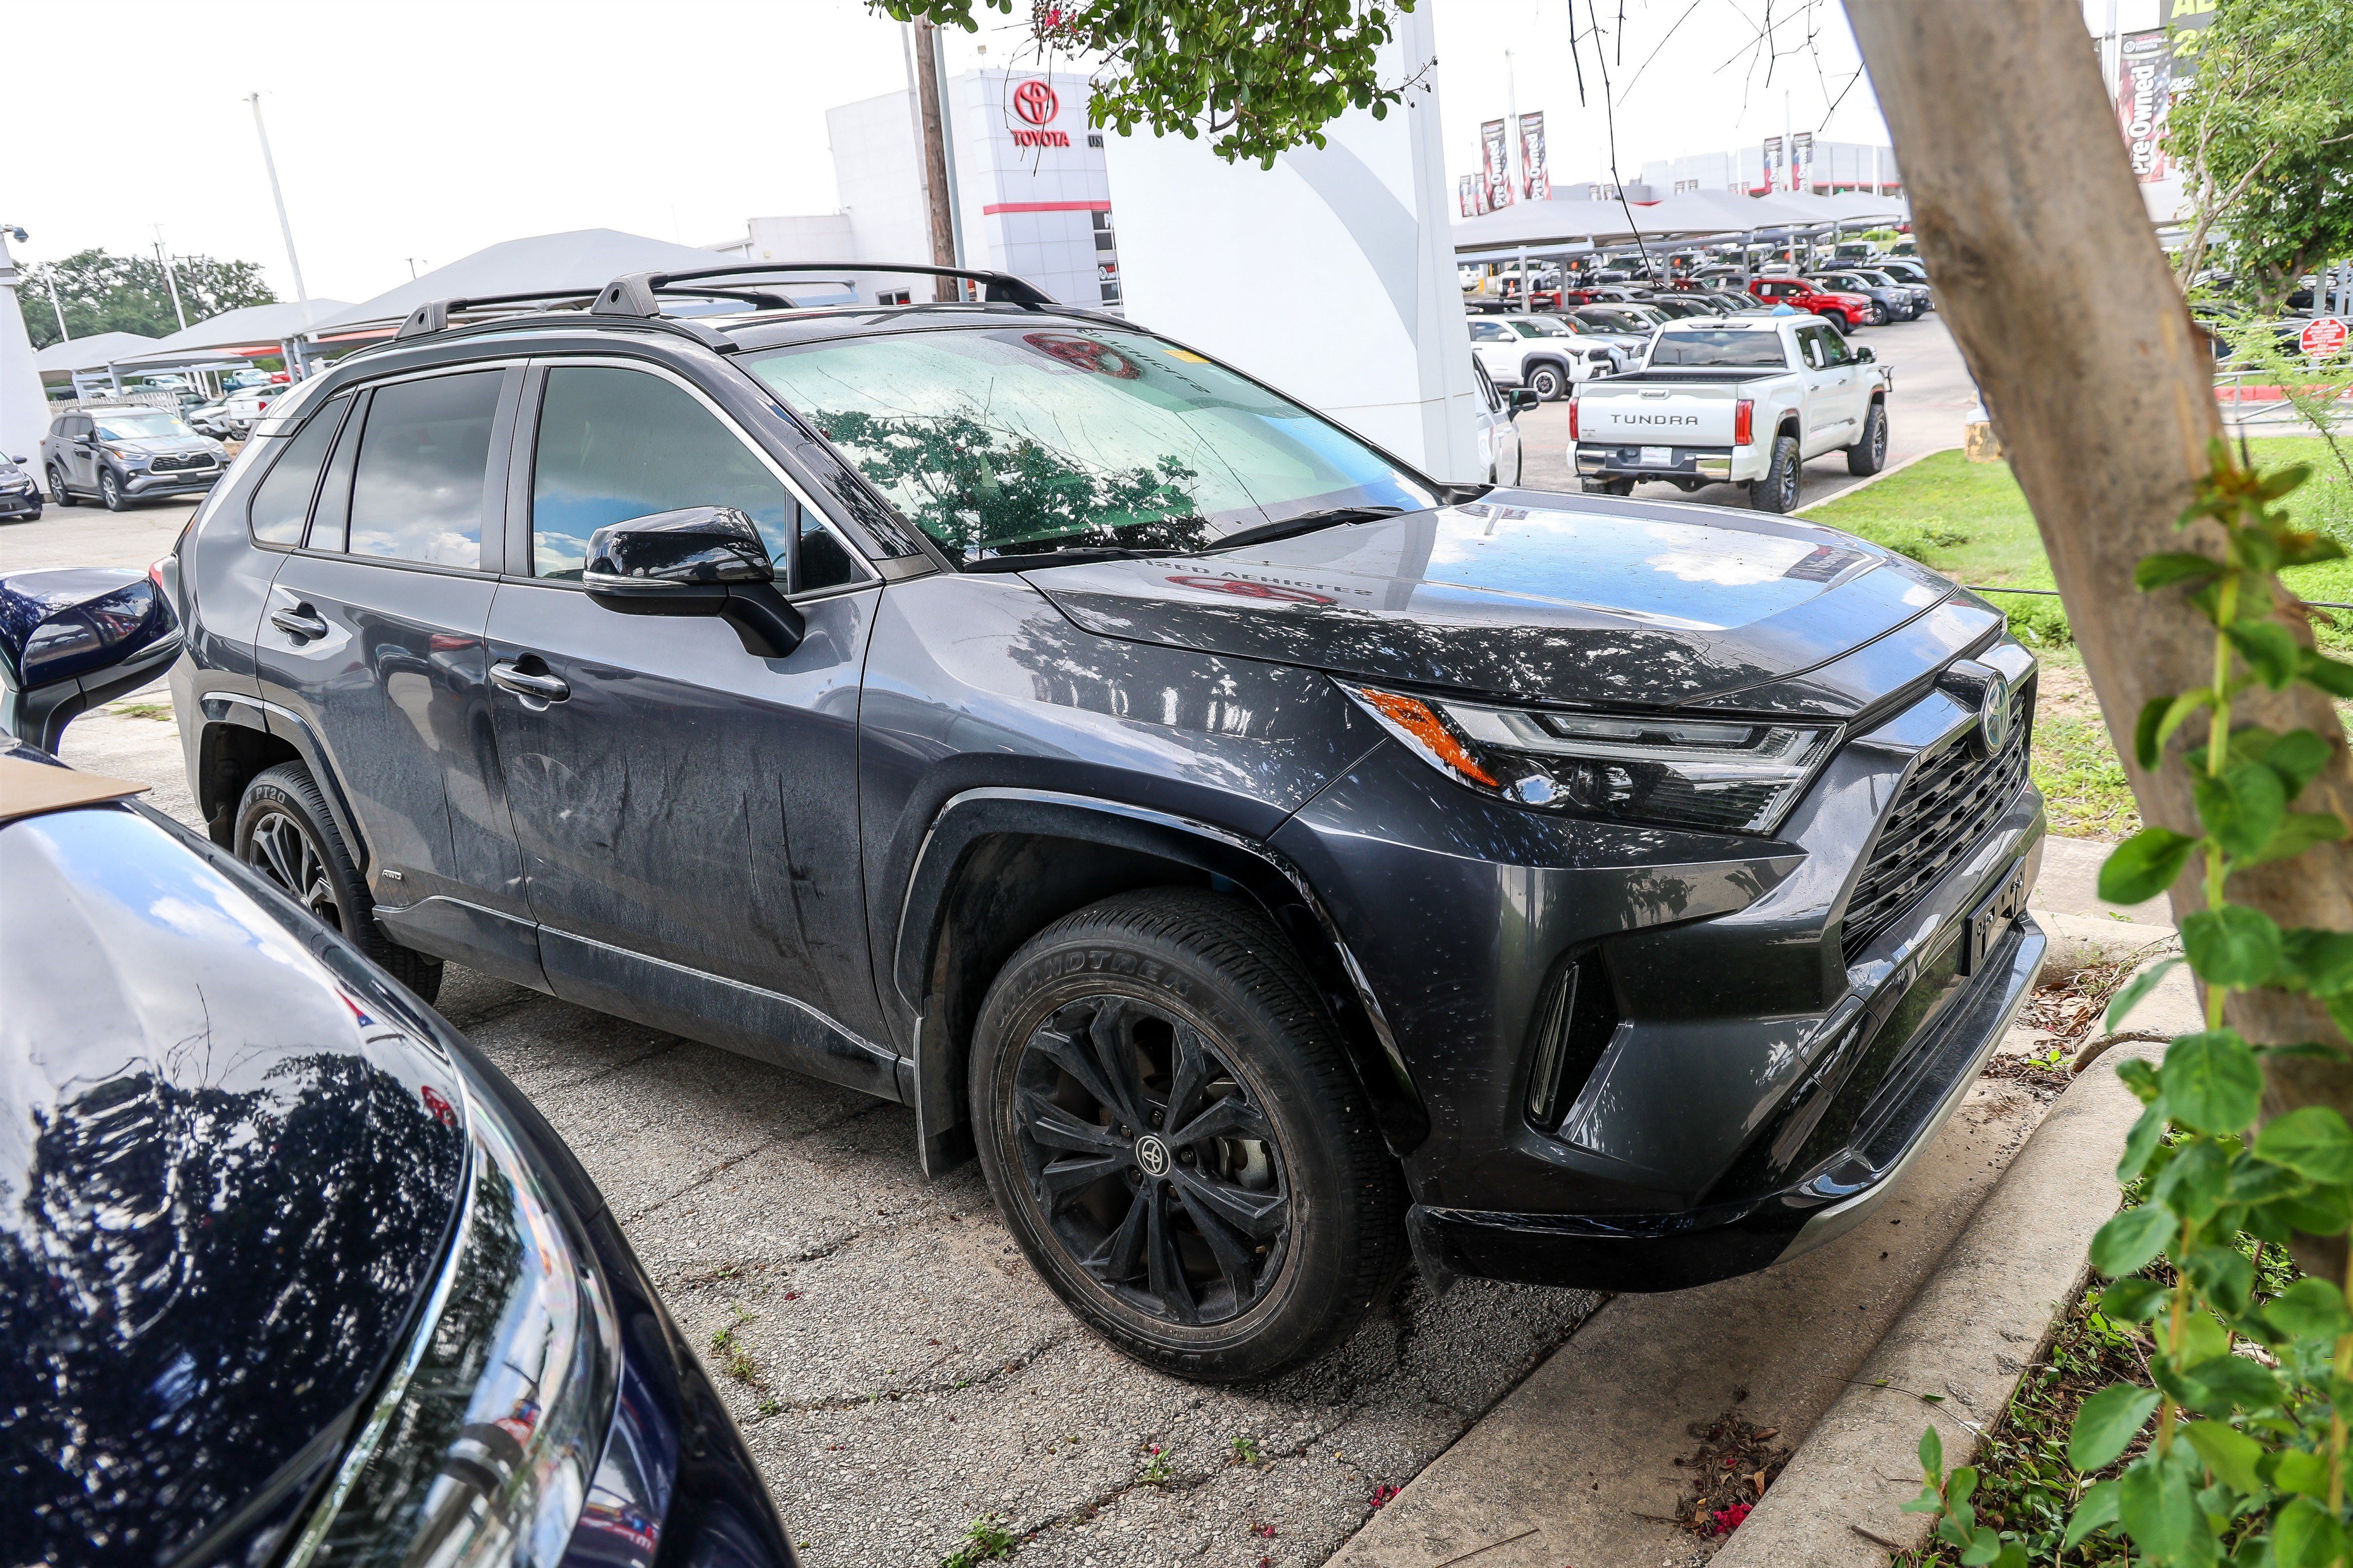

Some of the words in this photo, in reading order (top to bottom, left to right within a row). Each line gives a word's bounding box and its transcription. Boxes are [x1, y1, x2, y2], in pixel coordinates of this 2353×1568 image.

[2128, 64, 2155, 138] Owned
[1012, 129, 1070, 146] TOYOTA
[1486, 140, 1503, 185] Owned
[1525, 133, 1541, 179] Owned
[2131, 140, 2151, 175] Pre
[1494, 186, 1507, 208] Pre
[1611, 414, 1699, 425] TUNDRA
[256, 786, 286, 804] PT20
[381, 869, 402, 880] AWD
[994, 951, 1193, 1028] GRANDTREK
